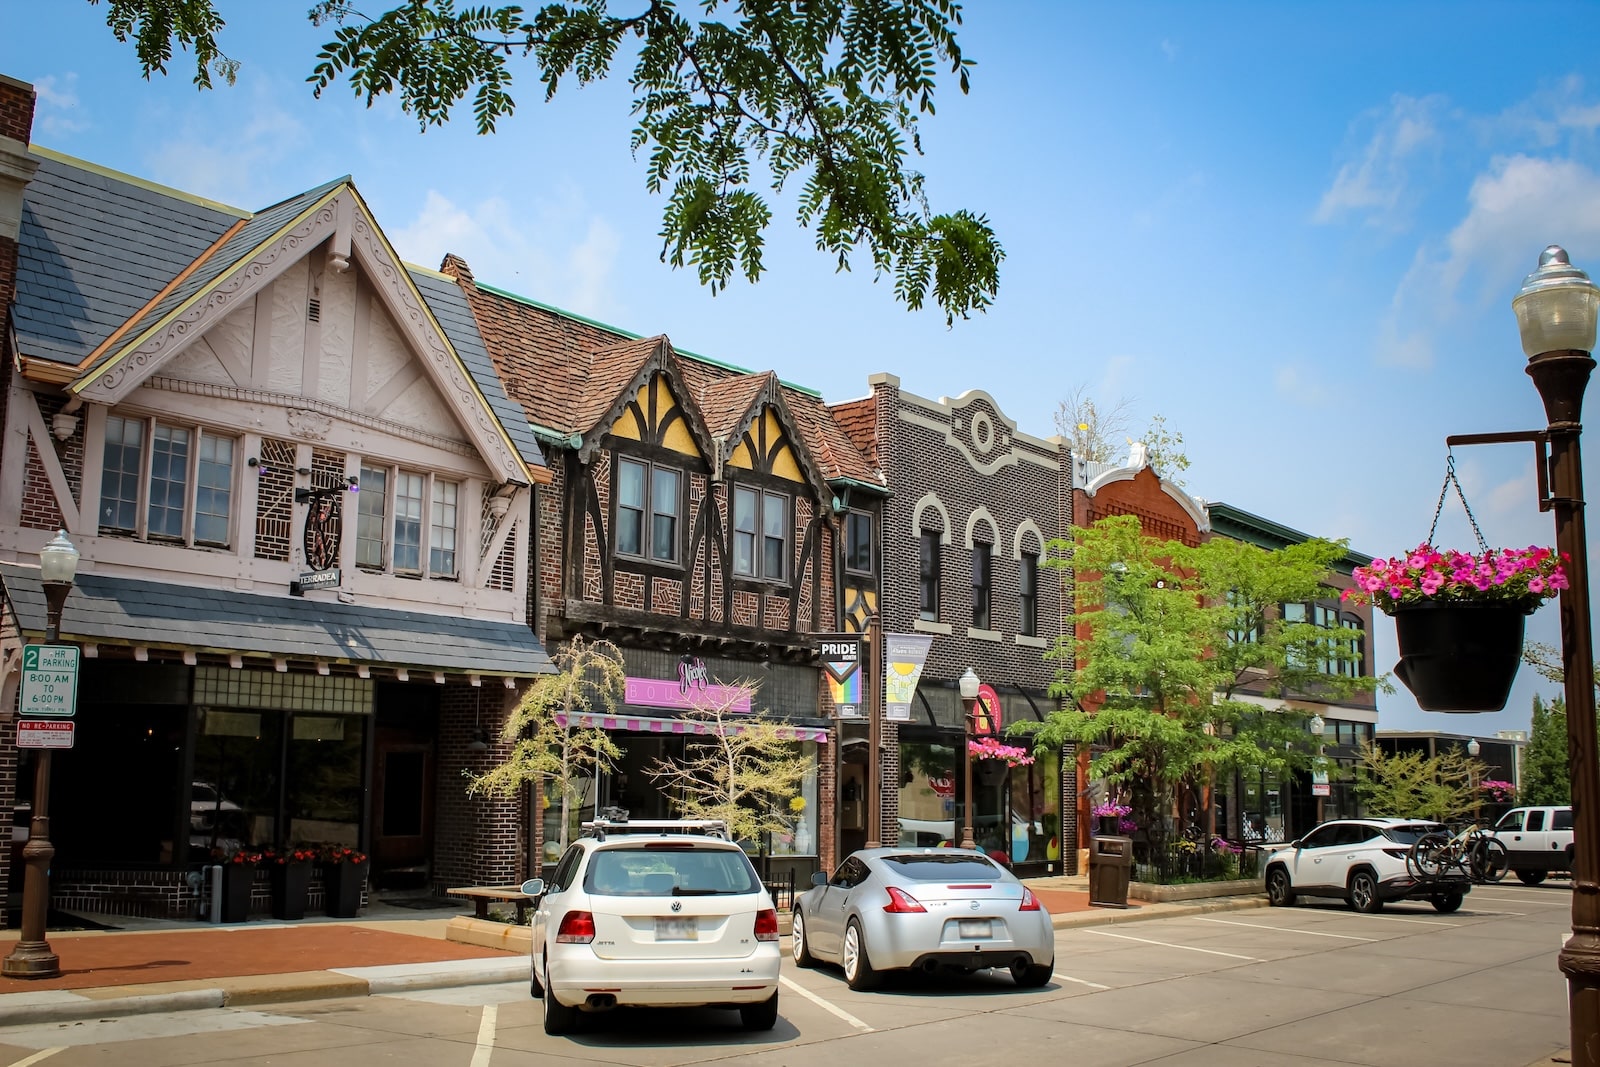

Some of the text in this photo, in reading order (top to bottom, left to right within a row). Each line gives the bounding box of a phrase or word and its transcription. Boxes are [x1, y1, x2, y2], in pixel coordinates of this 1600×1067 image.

[300, 573, 336, 584] TERRADEA
[54, 650, 66, 658] HR
[821, 643, 857, 655] PRIDE
[26, 651, 38, 667] 2
[42, 658, 75, 668] PARKING
[30, 673, 69, 683] 8:00 AM
[44, 684, 54, 693] TO
[32, 694, 64, 704] 6:00 PM
